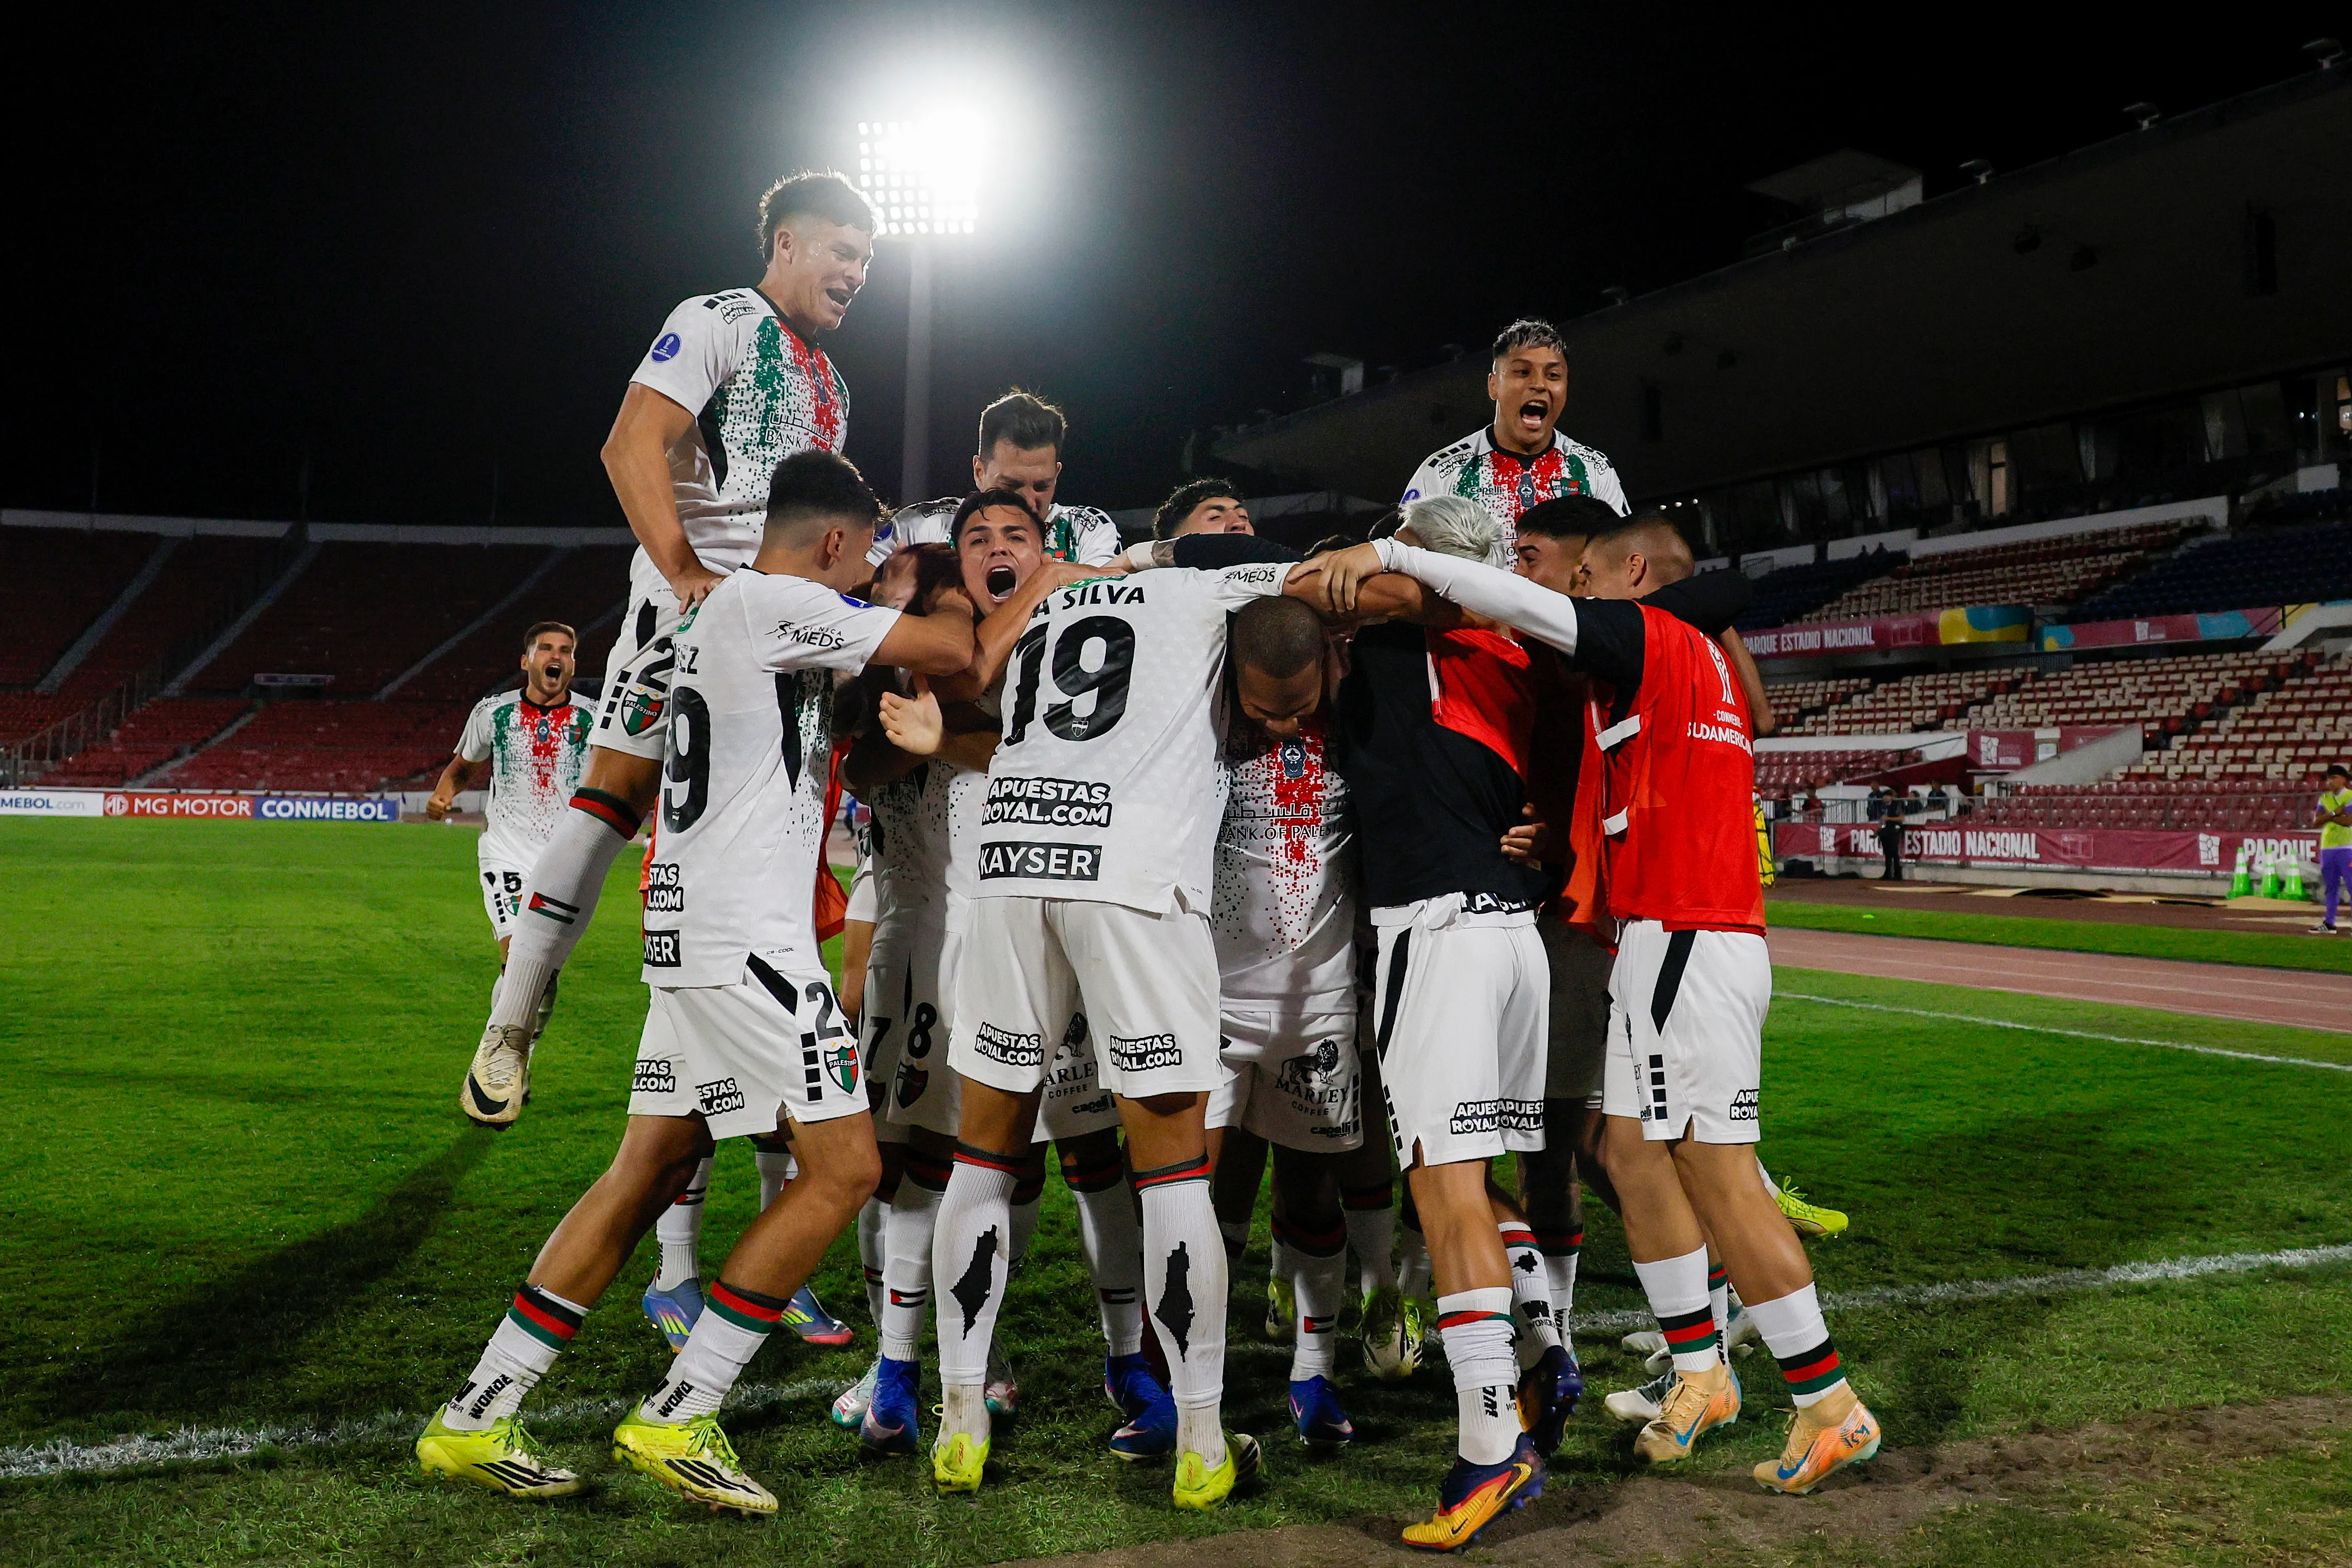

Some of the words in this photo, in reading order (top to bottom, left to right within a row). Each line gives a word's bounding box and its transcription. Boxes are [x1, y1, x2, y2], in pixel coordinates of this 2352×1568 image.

[766, 429, 802, 449] BANK
[1470, 486, 1502, 495] capelli
[1233, 570, 1276, 582] MEDS
[1062, 584, 1146, 610] SILVA
[790, 630, 845, 650] MEDS
[1743, 635, 1778, 655] PARQUE
[1781, 631, 1821, 652] ESTADIO
[1824, 626, 1875, 648] NACIONAL
[1004, 615, 1136, 747] 19
[625, 701, 658, 717] PALESTINO
[989, 780, 1108, 804] APUESTAS
[134, 797, 168, 815] MG
[173, 797, 251, 816] MOTOR
[261, 799, 389, 820] CONMEBOL
[982, 802, 1109, 824] ROYAL.COM
[1219, 825, 1259, 840] BANK
[1265, 826, 1287, 840] OF
[1905, 830, 1961, 857] ESTADIO
[1965, 831, 2041, 859] NACIONAL
[503, 872, 521, 893] 5
[805, 981, 851, 1040] 2
[908, 1002, 937, 1059] 8
[979, 1023, 1039, 1049] APUESTAS
[864, 1016, 892, 1071] 7
[976, 1037, 1042, 1064] ROYAL.COM
[829, 1058, 857, 1068] PALESTINO
[1110, 1051, 1180, 1069] RYAL.COM
[1048, 1084, 1088, 1099] COFFEE
[1274, 1077, 1349, 1104] MARLEY
[1072, 1094, 1108, 1113] capelli
[1292, 1101, 1329, 1116] COFFEE
